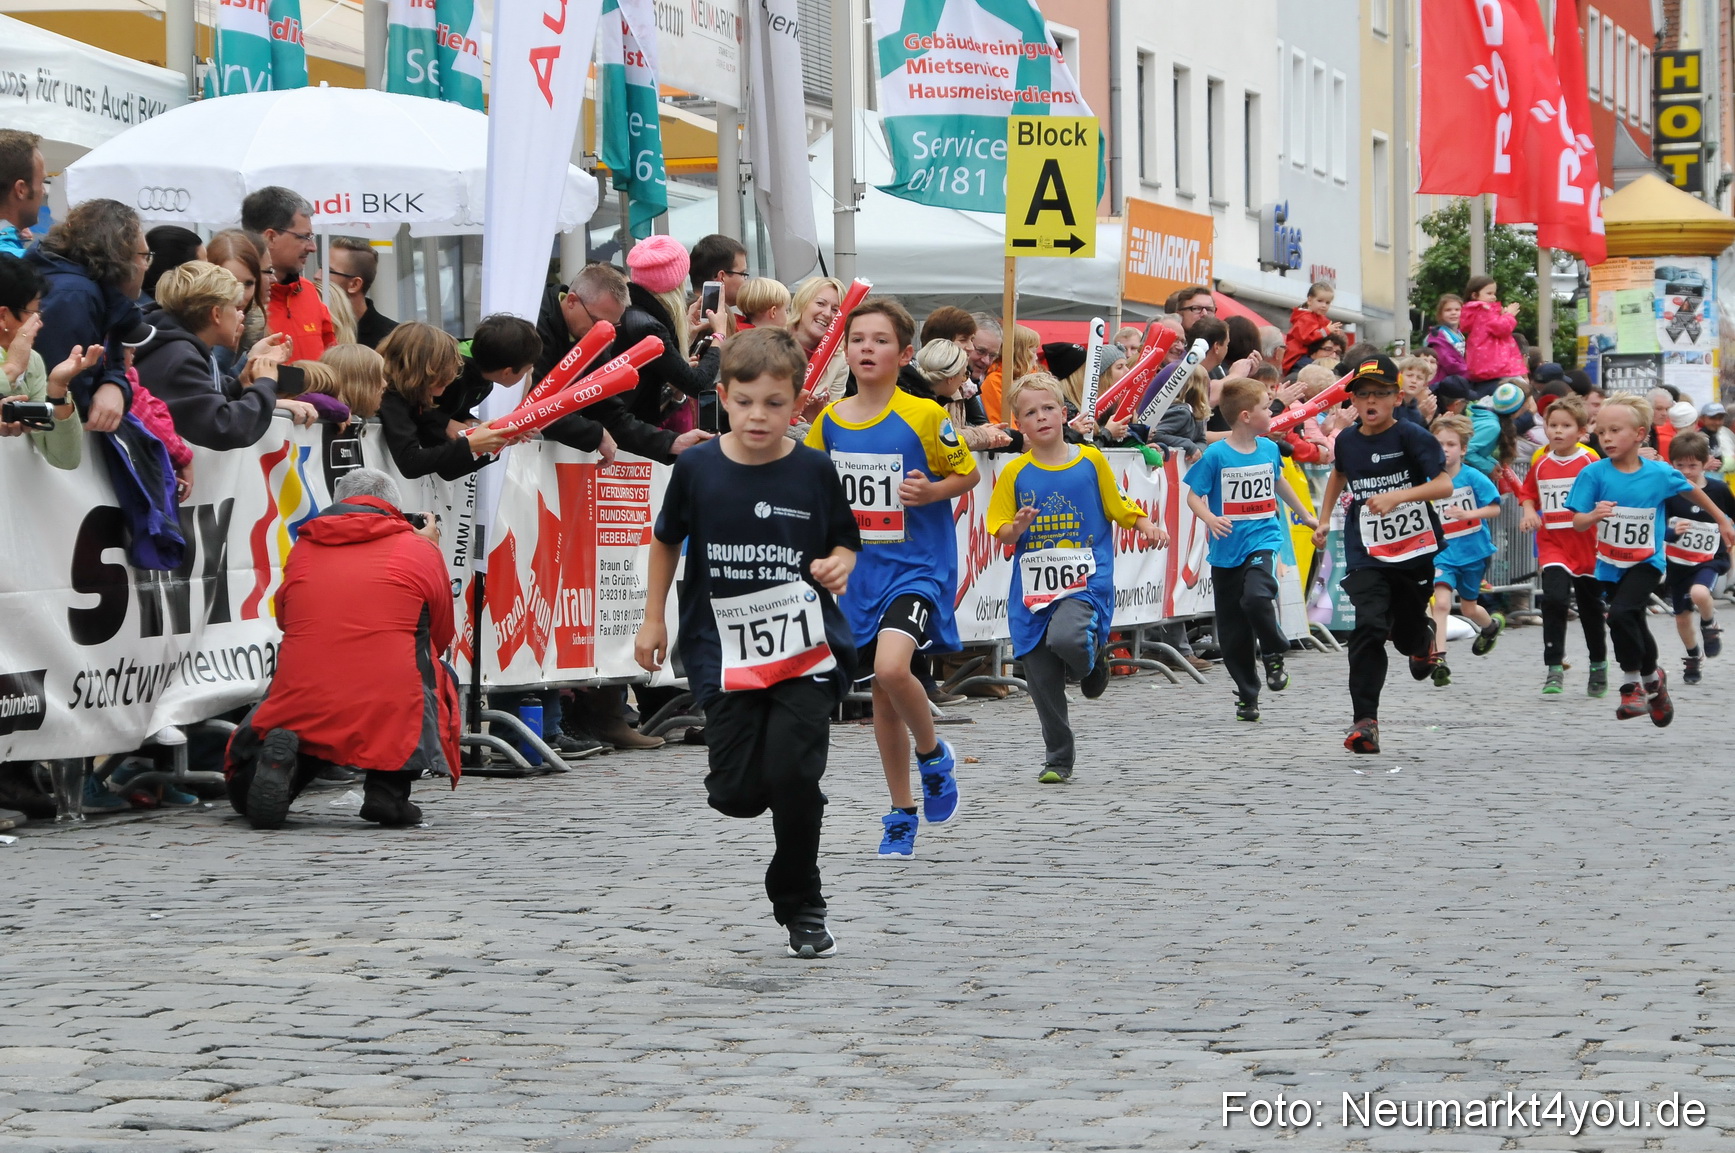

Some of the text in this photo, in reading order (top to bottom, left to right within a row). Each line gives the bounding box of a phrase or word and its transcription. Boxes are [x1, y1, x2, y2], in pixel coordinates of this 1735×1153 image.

[903, 32, 1066, 64] Gebäudereinigung
[906, 58, 1010, 79] Mietservice
[36, 67, 60, 104] für
[64, 82, 97, 114] uns:
[100, 85, 135, 124] Audi
[908, 83, 1080, 105] Hausmeisterdienst
[1017, 121, 1088, 147] Block
[907, 165, 988, 197] 09181
[1023, 158, 1077, 226] A
[362, 193, 424, 213] BKK
[815, 335, 831, 356] BKK
[533, 374, 555, 398] BKK
[1165, 366, 1188, 394] BMW
[537, 399, 565, 418] BKK
[845, 462, 887, 471] Neumarkt
[1244, 469, 1268, 477] Neumarkt
[1228, 477, 1272, 500] 7029
[1241, 504, 1264, 513] Lukas
[1366, 508, 1425, 543] 7523
[1602, 518, 1650, 545] 7158
[1020, 553, 1082, 564] PARTL Neumarkt
[1609, 548, 1634, 559] Kilian
[600, 559, 621, 571] Braun
[724, 565, 754, 580] Haus
[600, 574, 610, 586] Am
[1028, 563, 1090, 592] 7068
[600, 588, 627, 601] D-92318
[600, 609, 611, 621] Tel.
[715, 595, 800, 619] PARTL Neumarkt
[907, 600, 929, 633] 10
[494, 594, 525, 648] Braun
[600, 624, 611, 636] Fax
[727, 608, 813, 661] 7571
